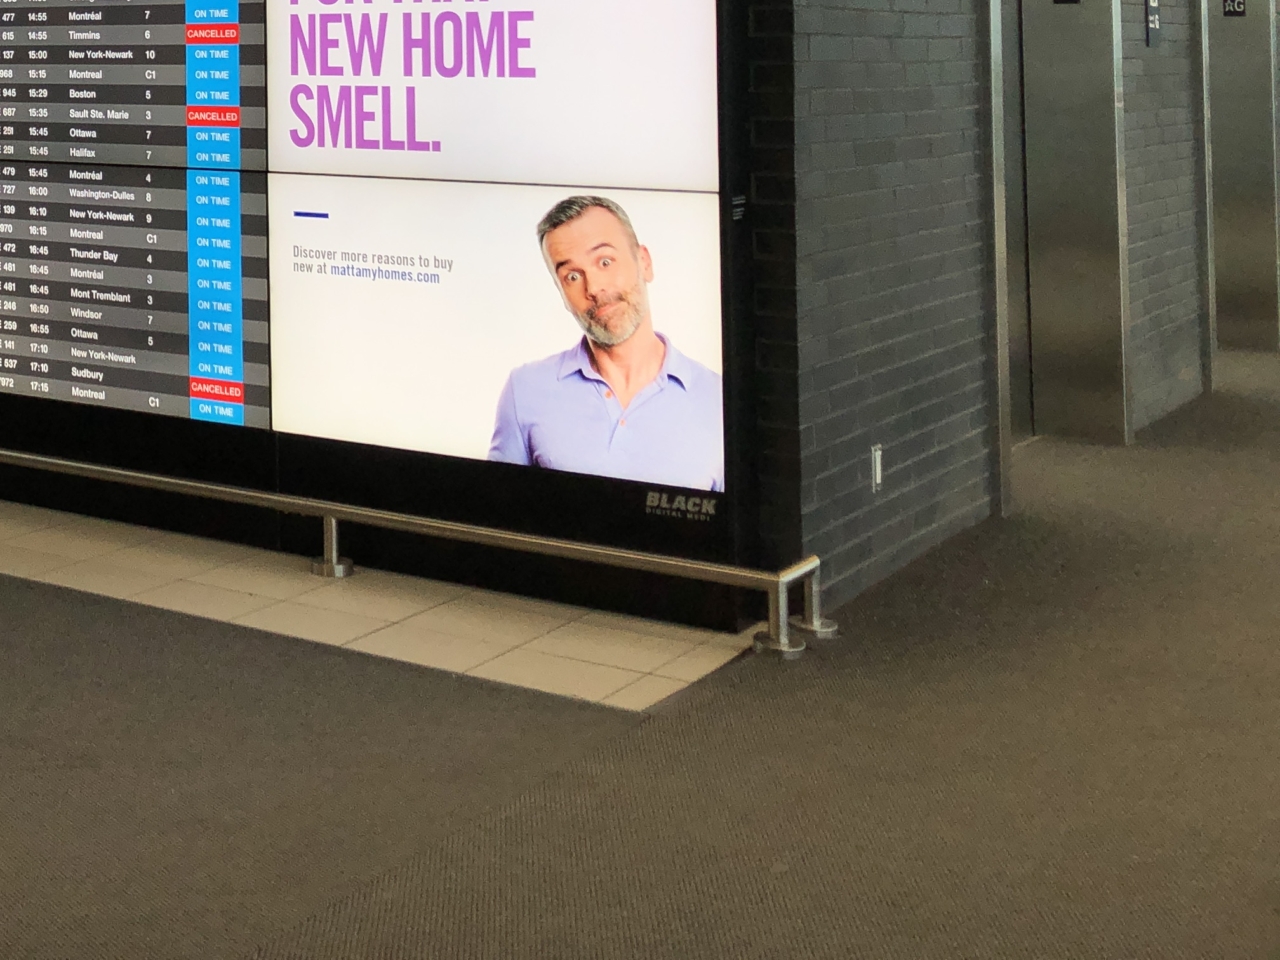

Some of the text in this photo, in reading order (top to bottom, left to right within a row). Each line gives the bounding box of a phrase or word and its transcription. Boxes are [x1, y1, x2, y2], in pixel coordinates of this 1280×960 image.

[2, 31, 14, 41] 615
[28, 30, 47, 41] 14:55
[68, 30, 100, 41] Timmins
[145, 30, 150, 40] 6
[187, 28, 237, 39] CANCELLED
[290, 11, 536, 78] NEW HOME
[3, 108, 16, 118] 687
[29, 108, 48, 118] 15:35
[69, 109, 89, 119] Sault
[90, 109, 105, 119] Ste.
[107, 110, 129, 120] Marie
[146, 110, 151, 120] 3
[188, 111, 238, 123] CANCELLED
[289, 84, 441, 151] SMELL.
[293, 244, 453, 273] Discover more reasons to buy
[293, 261, 440, 284] new at mattamyhomes.com
[70, 288, 152, 305] Mont Tremblant 3
[4, 340, 15, 350] 141
[30, 343, 49, 355] 17:10
[71, 347, 86, 360] New
[88, 350, 136, 365] York-Newark
[198, 363, 211, 374] ON
[213, 364, 233, 376] TIME
[646, 492, 717, 514] BLACK
